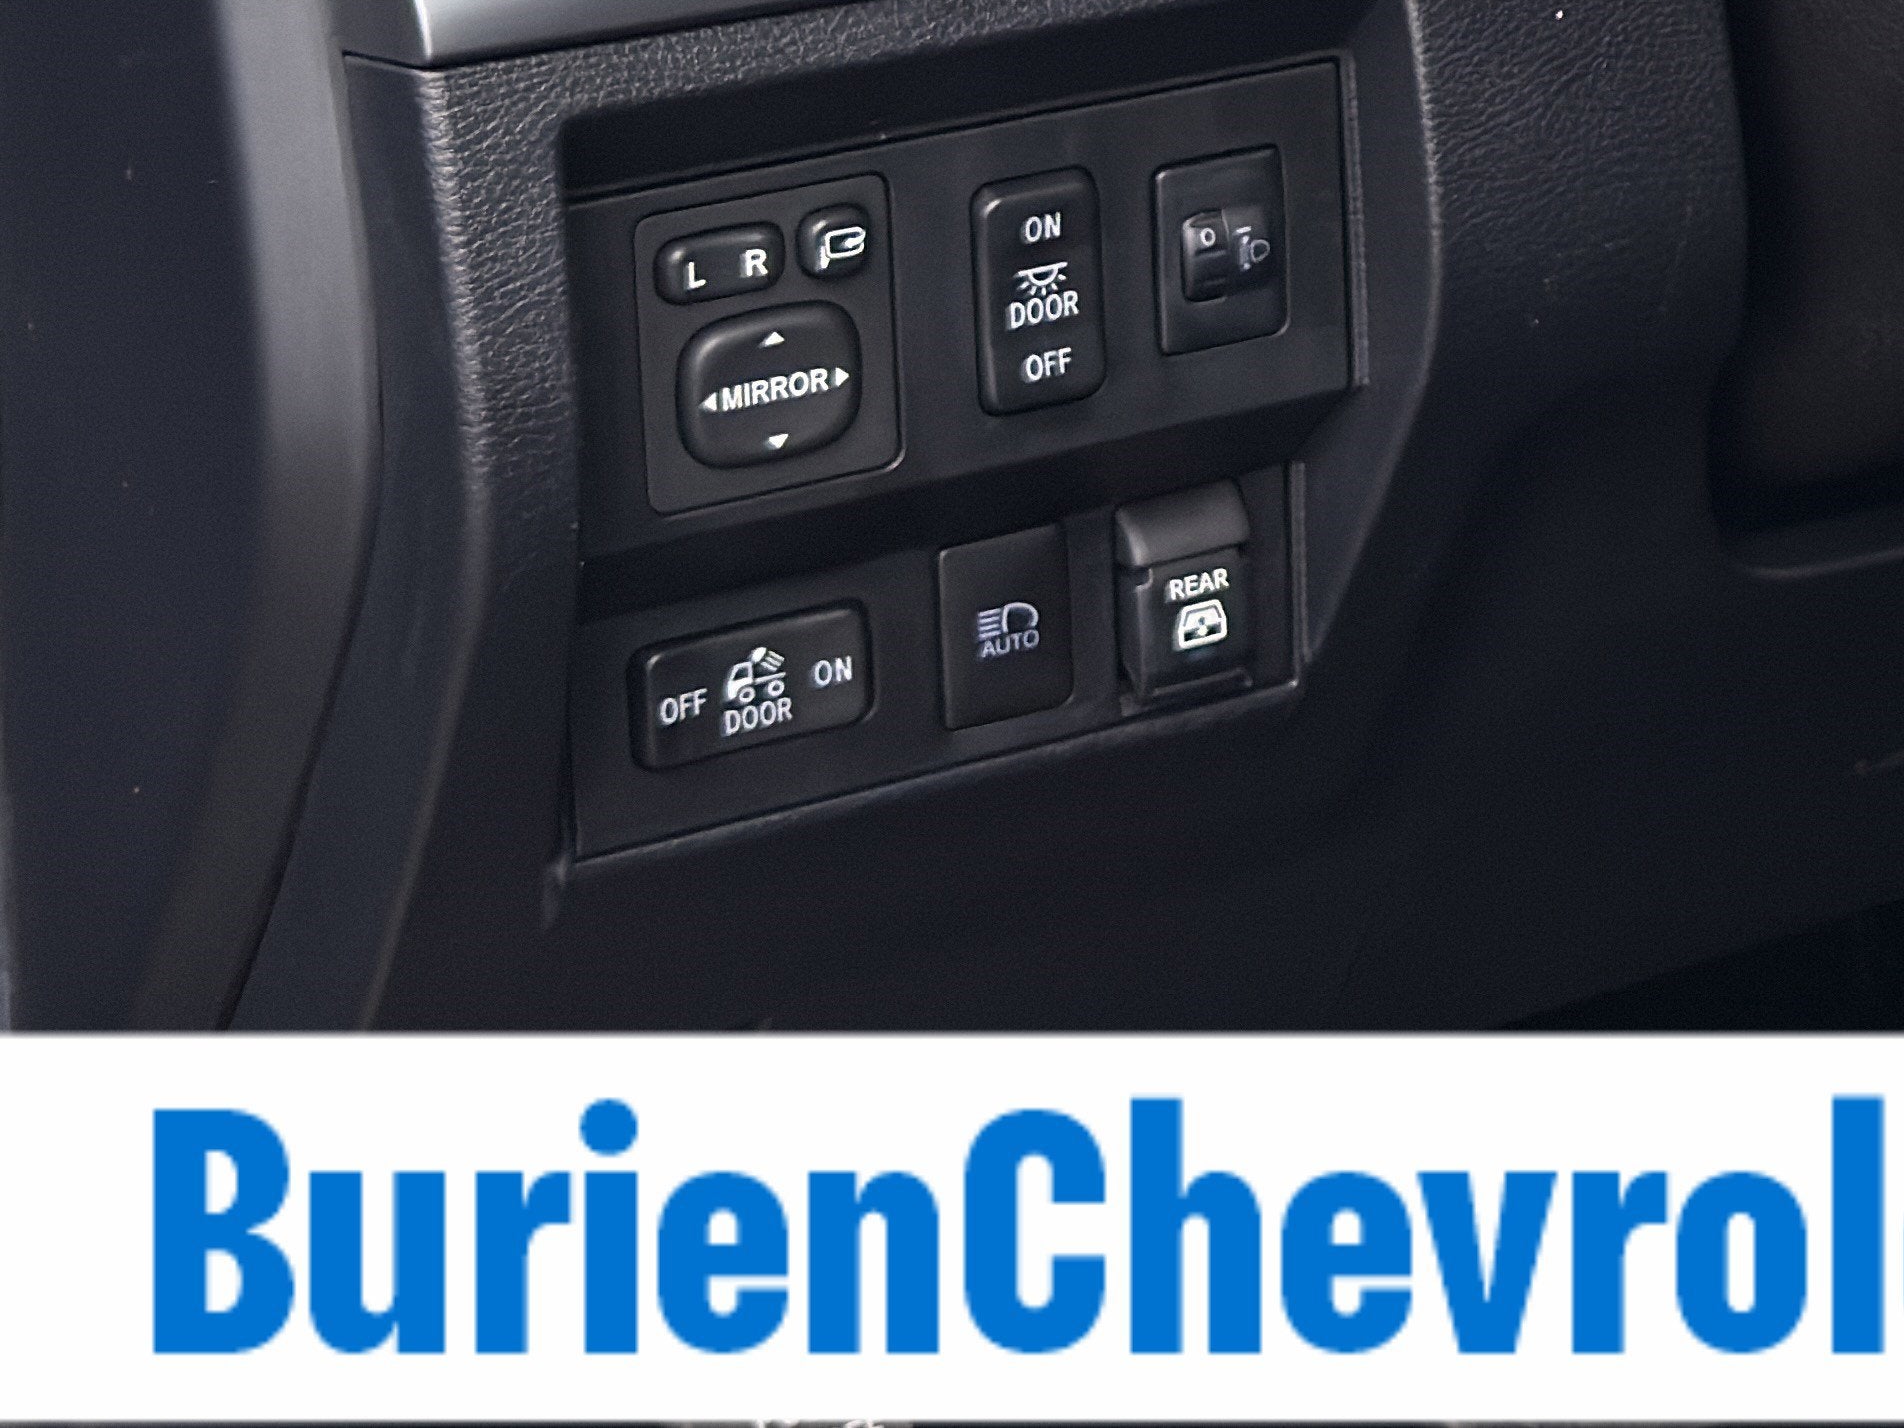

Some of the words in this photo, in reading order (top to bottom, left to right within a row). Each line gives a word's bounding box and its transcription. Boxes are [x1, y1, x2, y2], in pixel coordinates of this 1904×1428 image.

[1021, 211, 1062, 244] ON
[685, 260, 707, 291] L
[741, 247, 769, 279] R
[1006, 289, 1080, 331] DOOR
[1022, 346, 1073, 383] OFF
[721, 367, 830, 412] MIRROR
[1166, 567, 1230, 602] REAR
[978, 628, 1041, 659] AUTO
[658, 687, 709, 726] OFF
[811, 654, 853, 687] ON
[721, 696, 794, 738] DOOR
